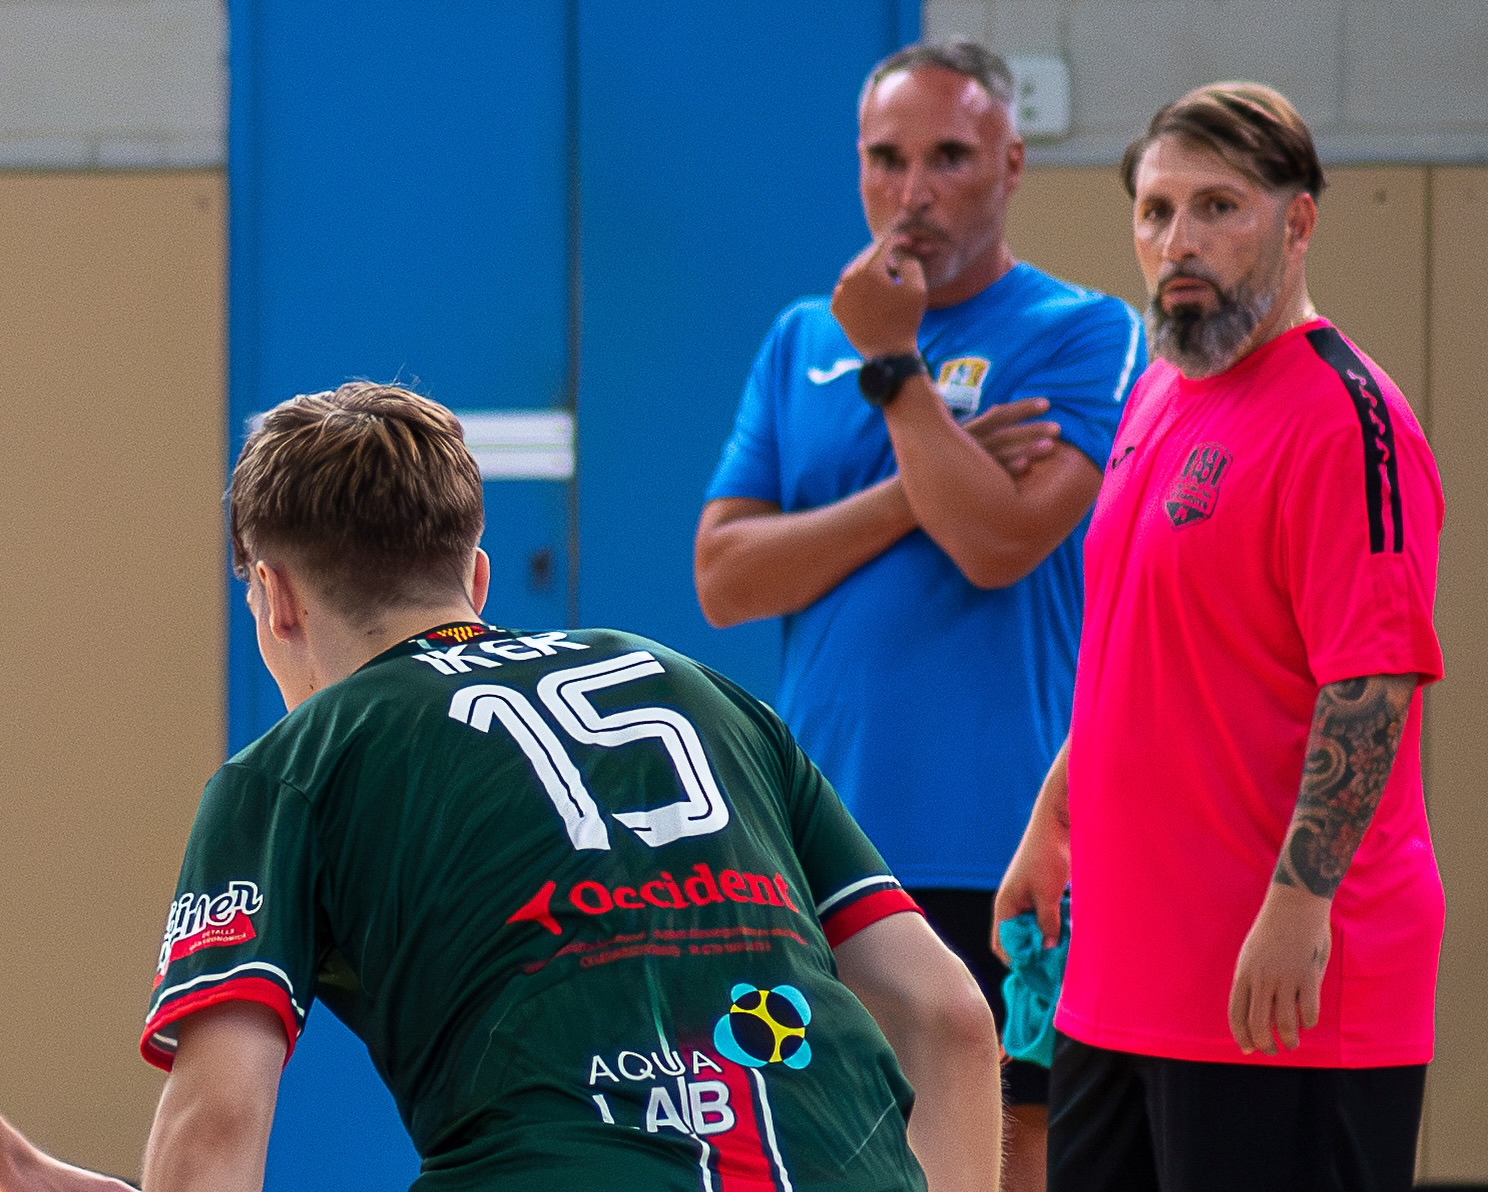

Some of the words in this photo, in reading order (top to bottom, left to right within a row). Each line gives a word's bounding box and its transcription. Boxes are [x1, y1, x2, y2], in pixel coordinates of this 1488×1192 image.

[412, 631, 591, 676] IKER
[449, 651, 730, 851] 15
[569, 863, 800, 914] Occident
[589, 1051, 723, 1085] AQUA
